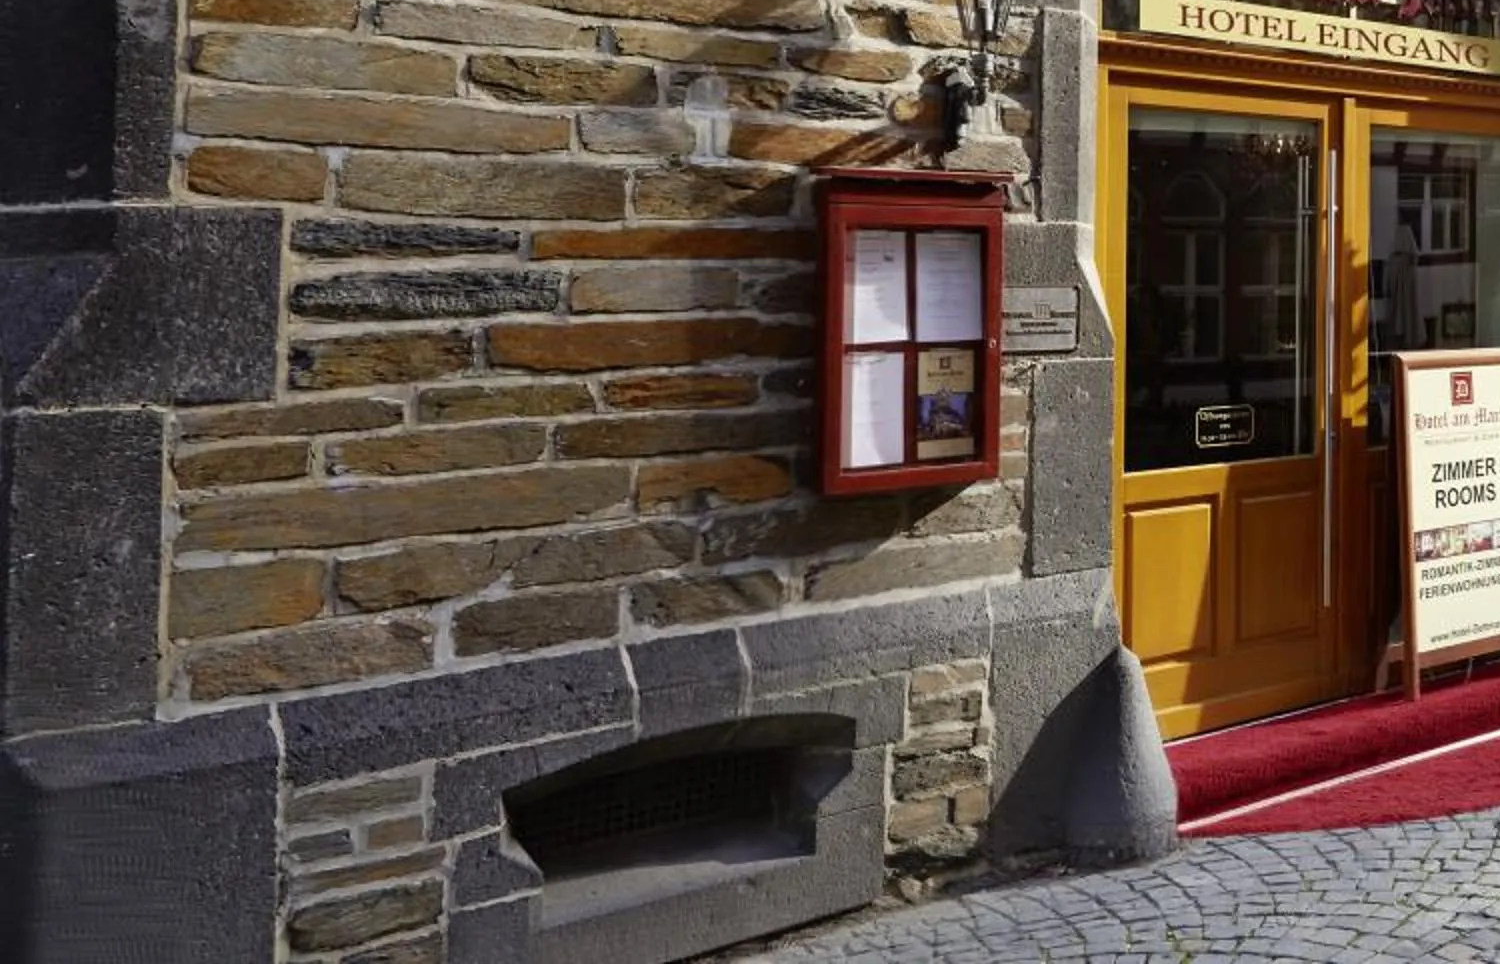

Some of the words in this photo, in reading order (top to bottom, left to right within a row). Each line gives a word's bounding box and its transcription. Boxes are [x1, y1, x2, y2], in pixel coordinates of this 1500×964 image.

[1180, 4, 1308, 44] HOTEL
[1316, 24, 1491, 71] EINGANG
[1414, 411, 1449, 431] Hotel
[1451, 413, 1471, 428] am
[1432, 457, 1497, 483] ZIMMER
[1435, 482, 1497, 509] ROOMS
